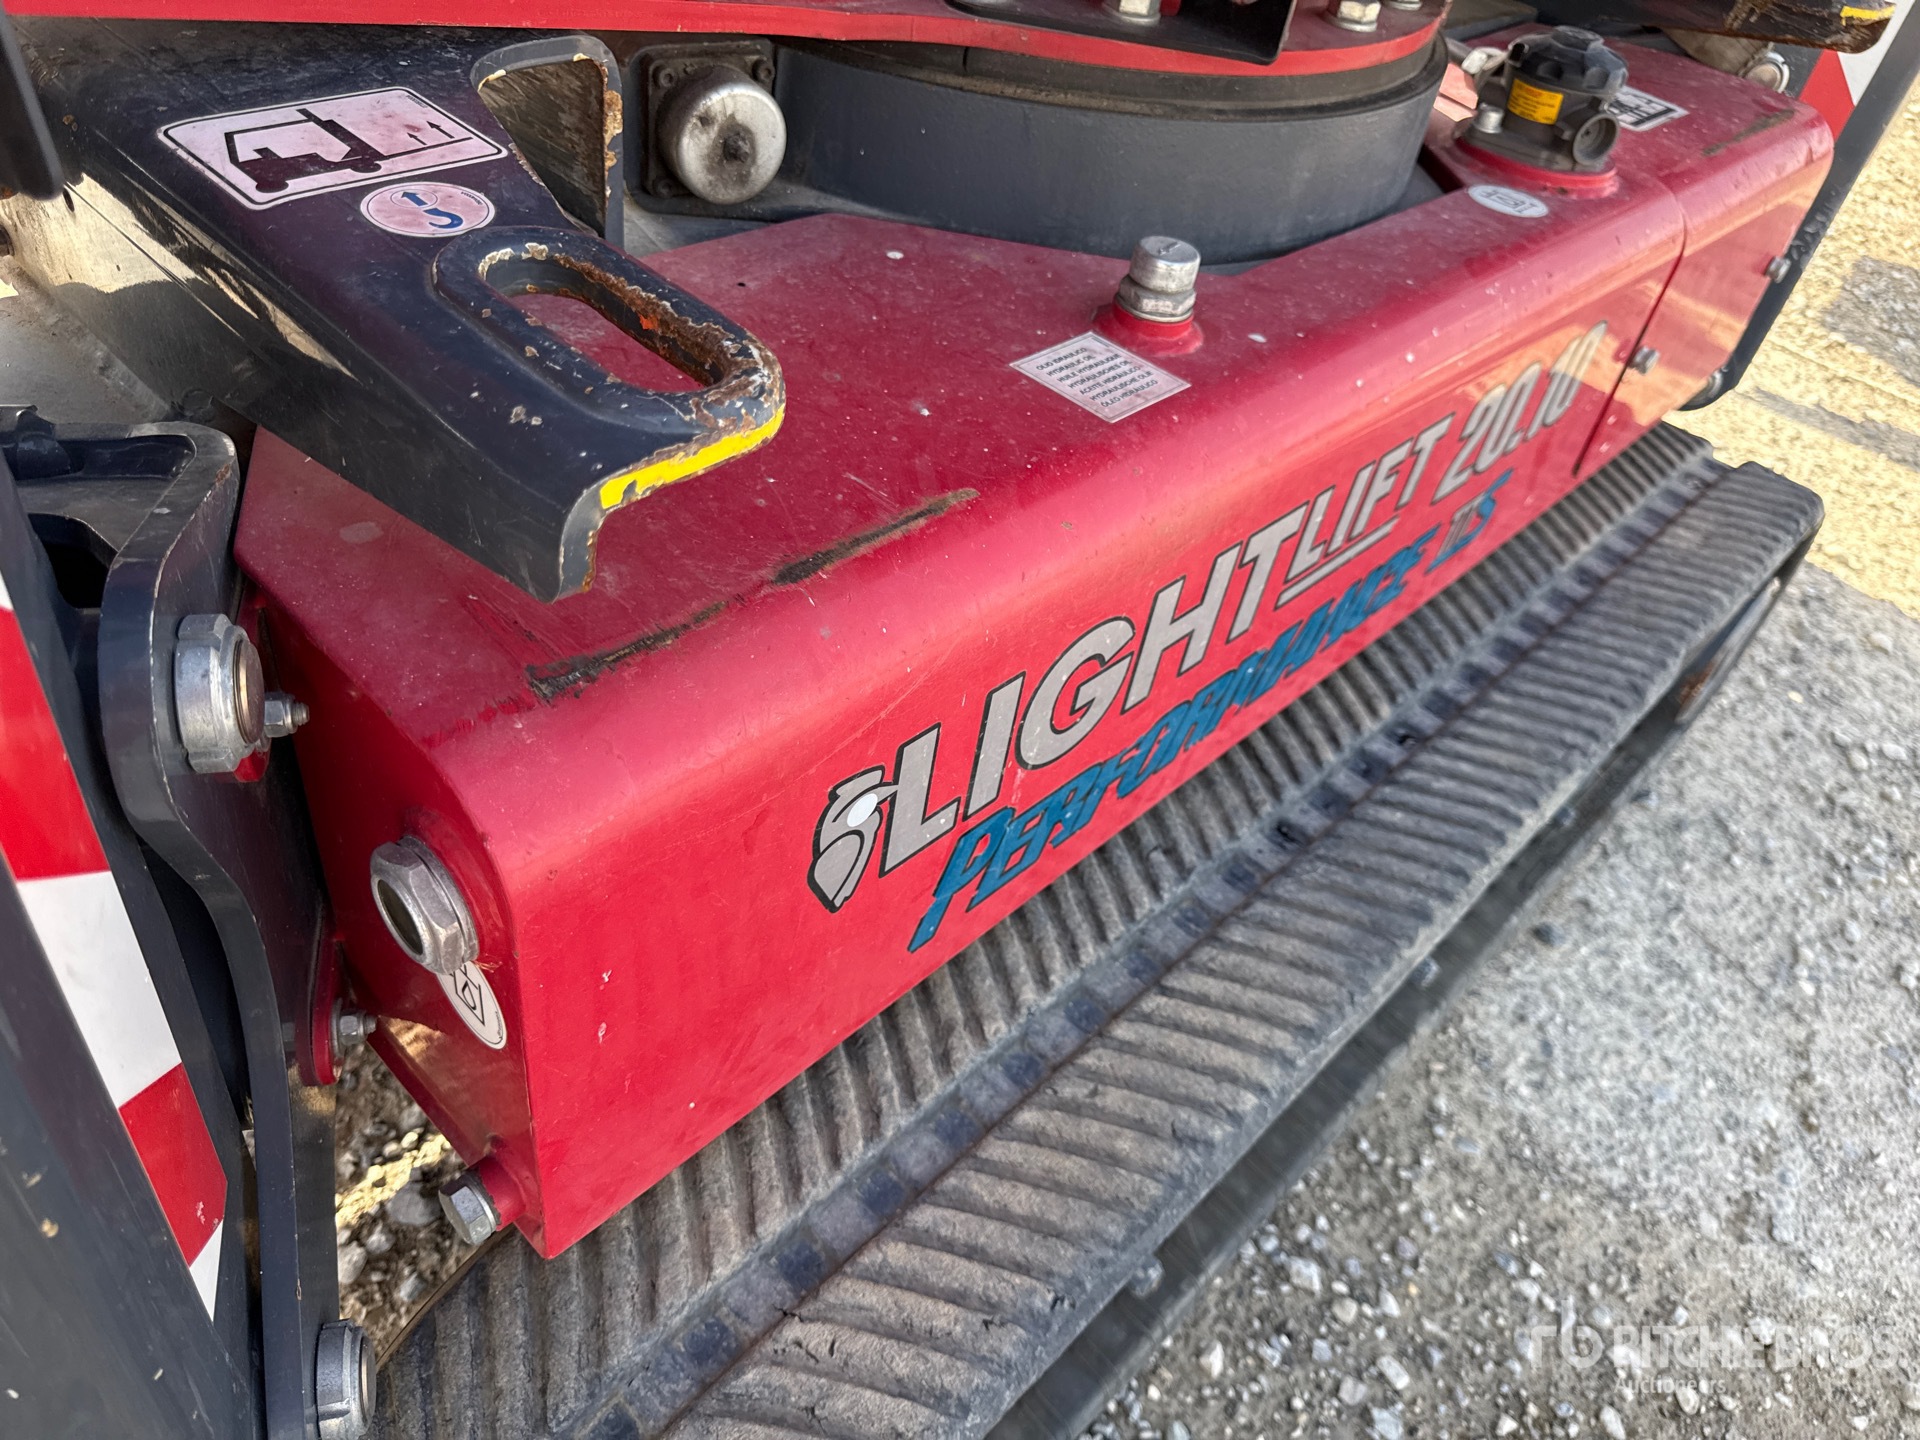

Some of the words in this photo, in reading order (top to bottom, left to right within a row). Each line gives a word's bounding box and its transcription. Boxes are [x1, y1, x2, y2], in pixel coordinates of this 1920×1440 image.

[1036, 361, 1054, 371] OLIO
[1052, 348, 1087, 364] IDRAULICO
[1046, 360, 1084, 377] HYDRAULIC
[1080, 381, 1104, 395] ACEITE
[1429, 320, 1608, 504] 20.10
[907, 522, 1443, 953] PERFORMANCE
